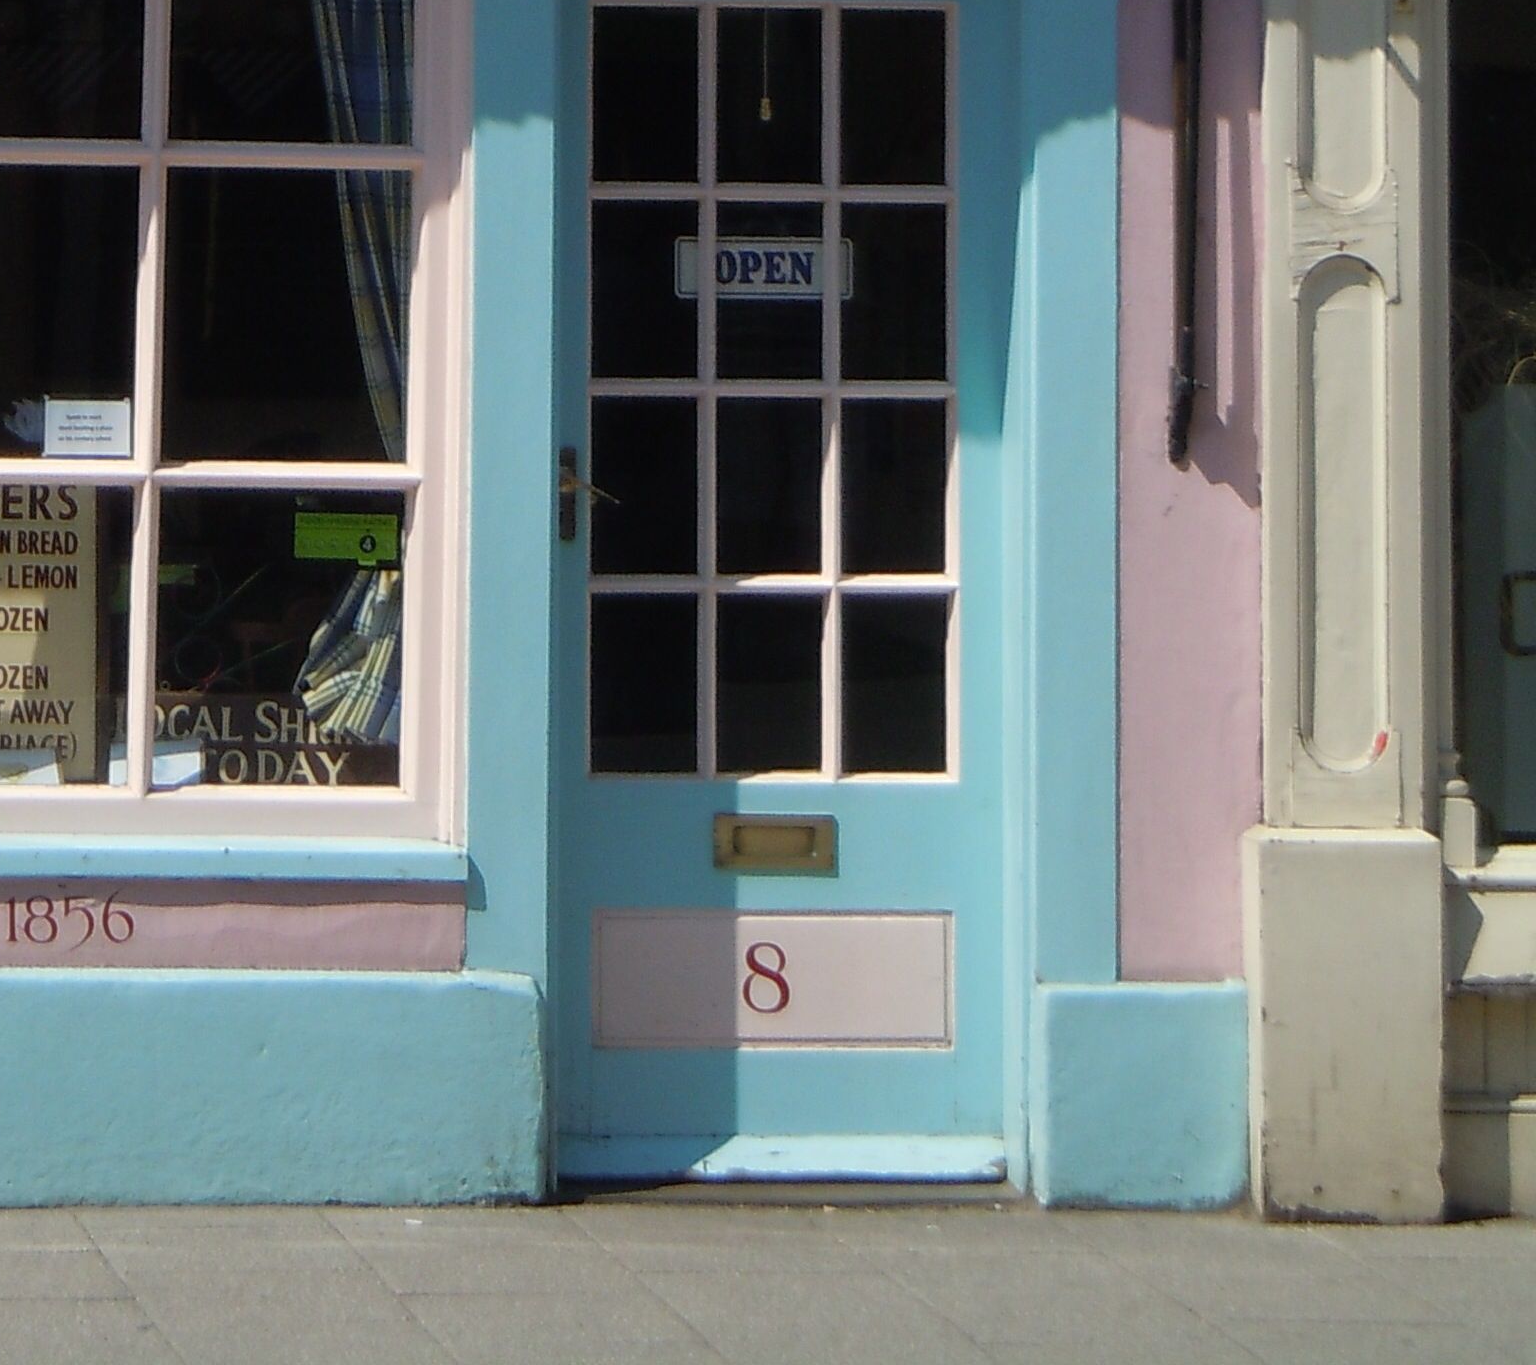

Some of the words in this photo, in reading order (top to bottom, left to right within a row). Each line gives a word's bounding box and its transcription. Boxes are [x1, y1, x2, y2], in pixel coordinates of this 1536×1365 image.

[715, 250, 815, 285] OPEN
[17, 530, 79, 555] BREAD
[8, 565, 78, 589] LEMON
[10, 700, 75, 725] AWAY
[6, 889, 135, 950] 1856
[743, 941, 791, 1014] 8
